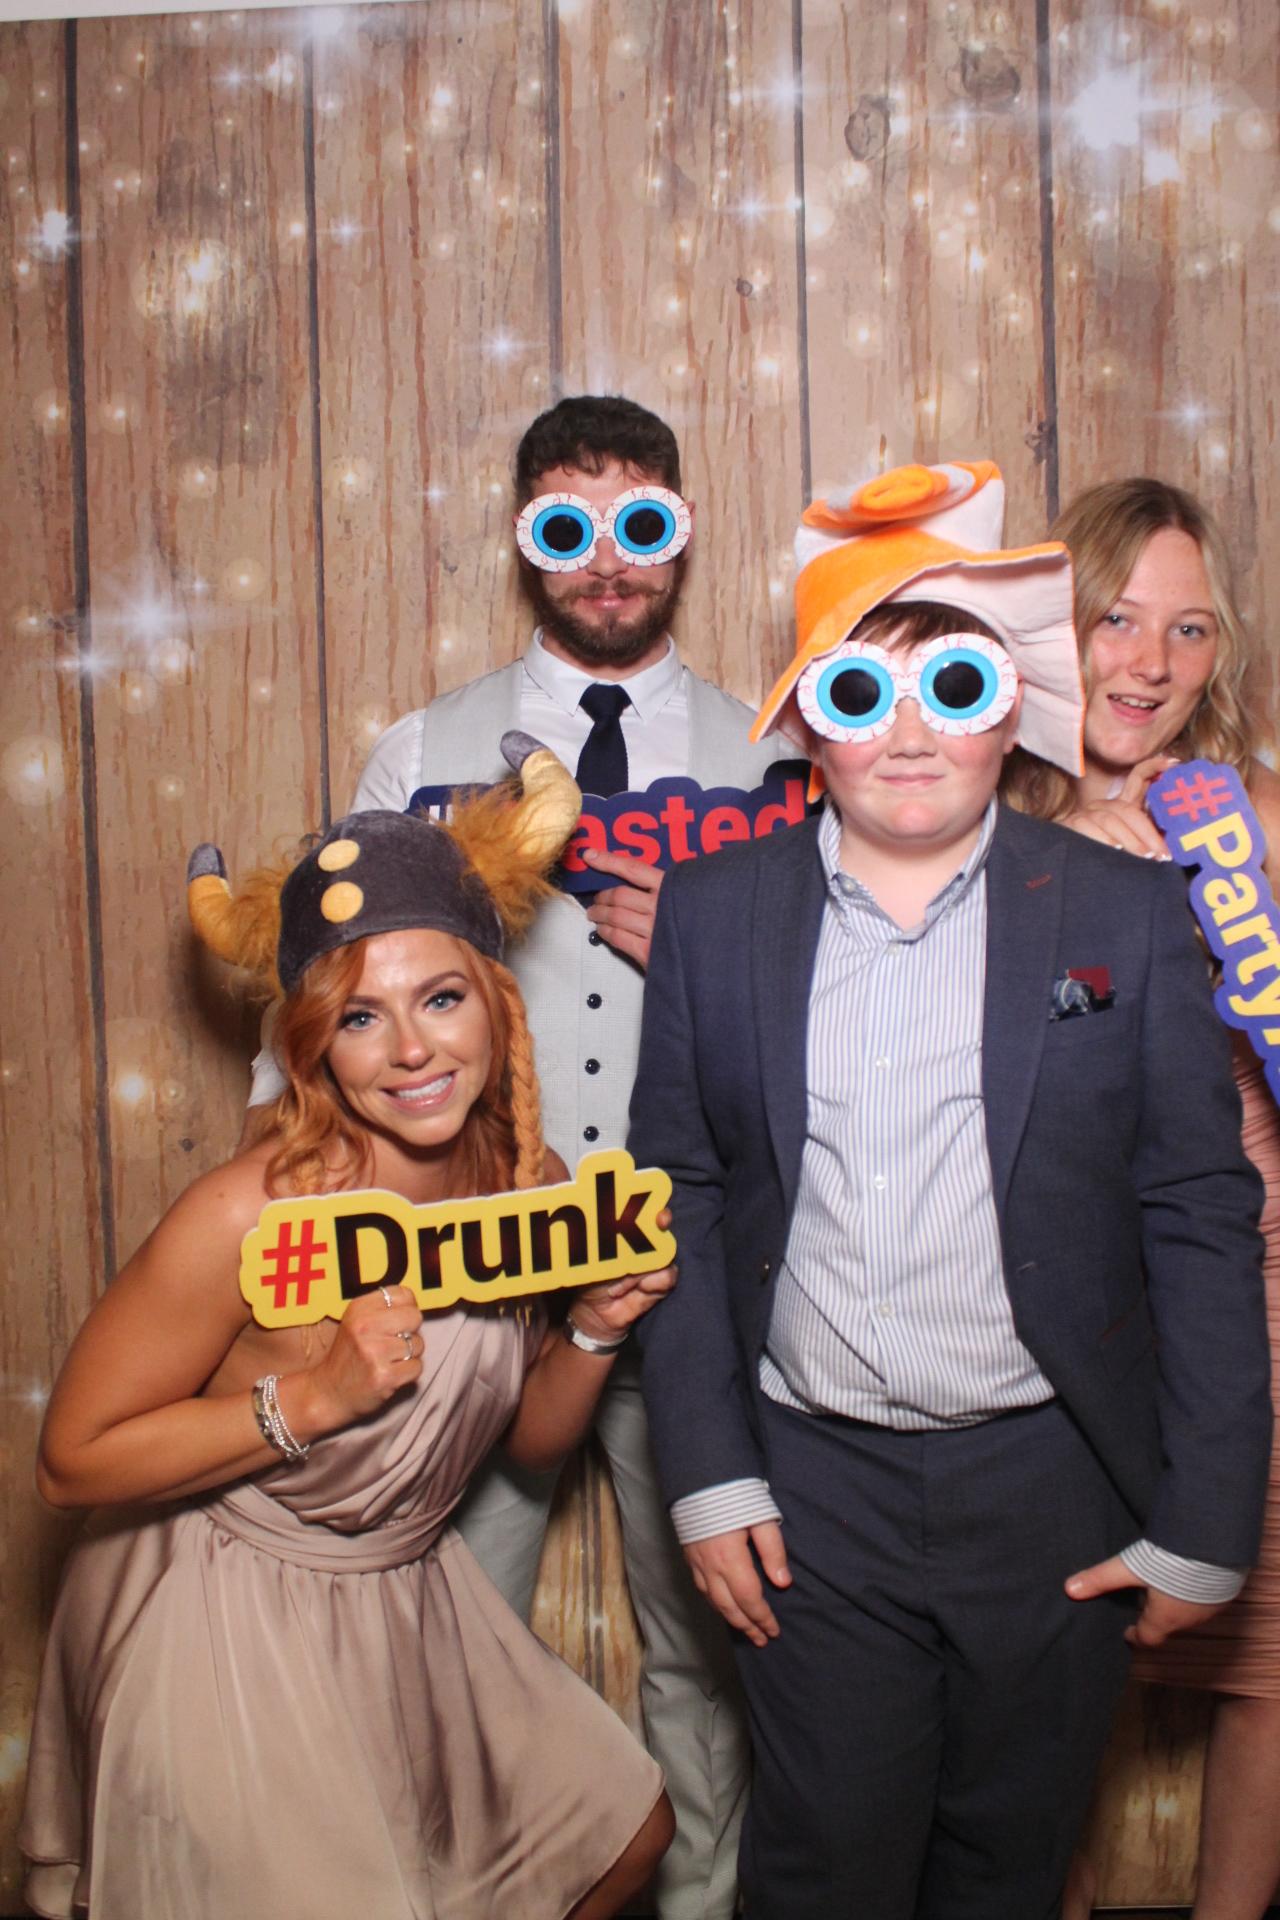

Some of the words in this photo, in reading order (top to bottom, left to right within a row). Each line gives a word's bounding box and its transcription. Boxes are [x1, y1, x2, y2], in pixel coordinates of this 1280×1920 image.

[428, 779, 806, 872] asted
[1161, 771, 1280, 1073] #Party
[260, 1169, 657, 1310] #Drunk
